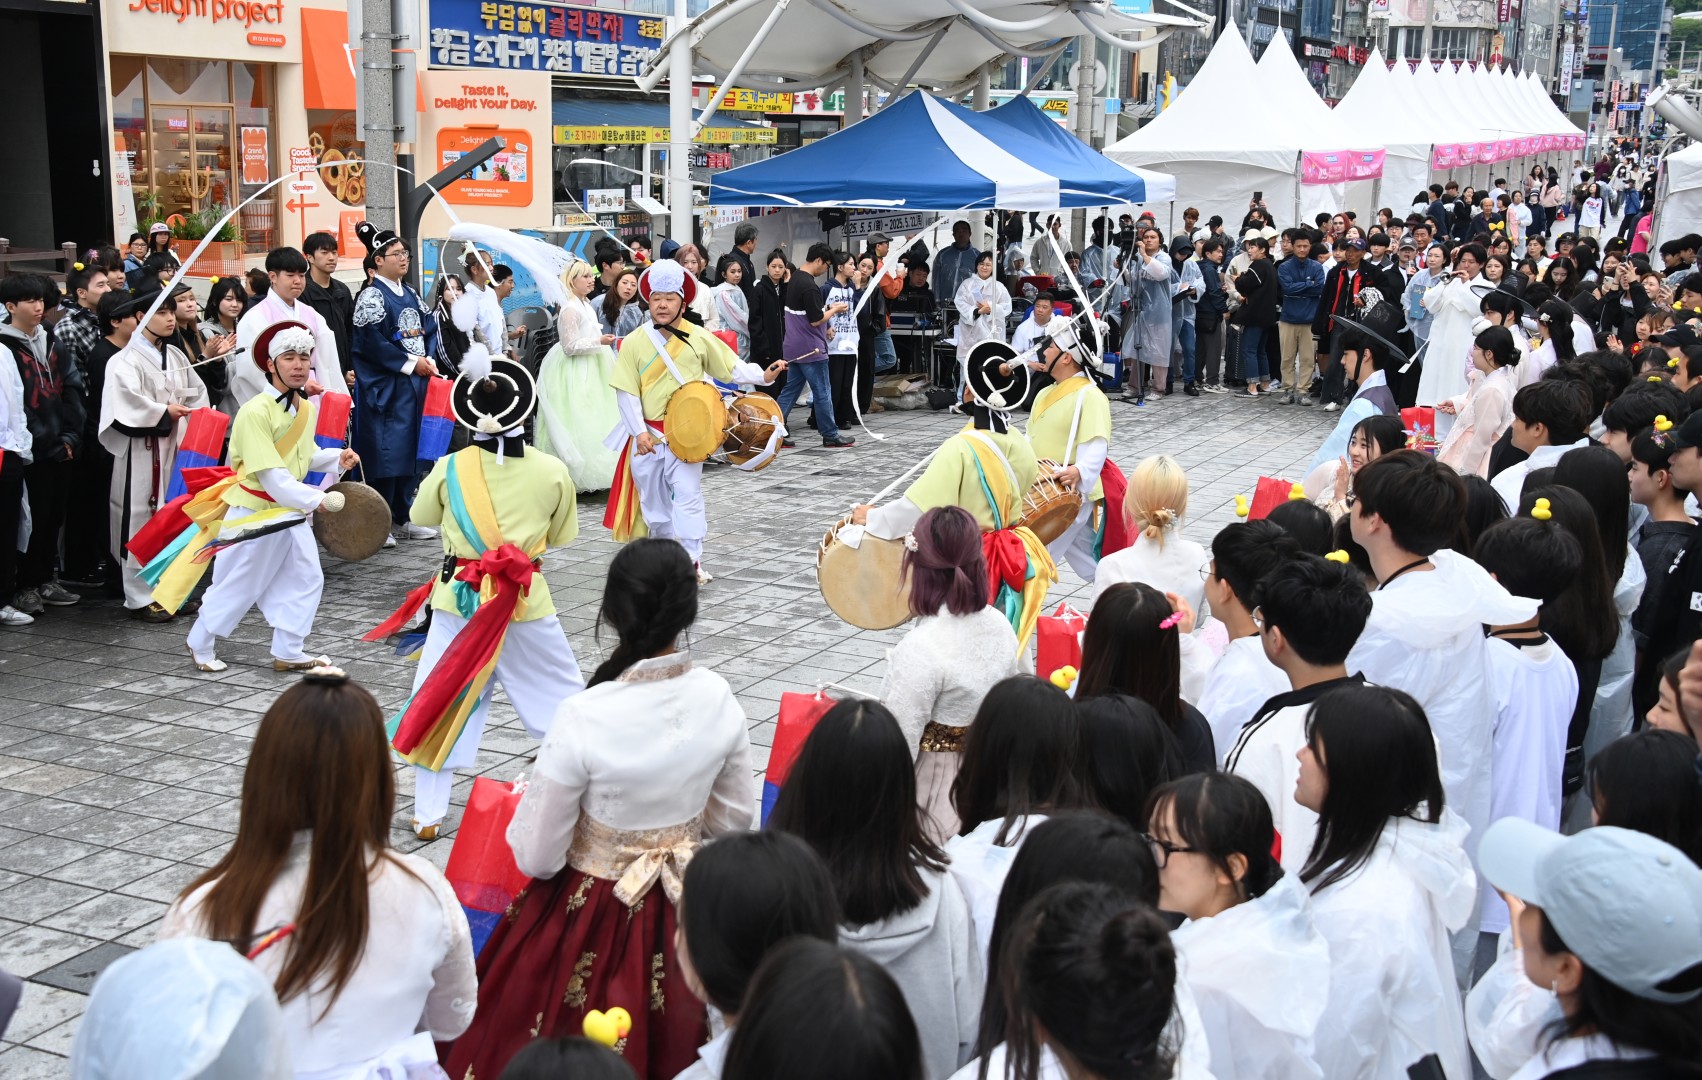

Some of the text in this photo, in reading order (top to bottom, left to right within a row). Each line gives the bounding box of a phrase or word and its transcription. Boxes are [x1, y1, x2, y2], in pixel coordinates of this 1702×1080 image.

[212, 0, 285, 28] project
[638, 19, 663, 39] 3호점
[431, 28, 470, 64] 황금
[474, 34, 540, 69] 조개구이
[541, 38, 573, 71] 횟집
[574, 40, 619, 74] 해물탕
[461, 85, 509, 97] Taste It,
[711, 90, 791, 107] 금 조개구이 회
[434, 98, 537, 111] Delight Your Day.
[461, 136, 483, 145] Delight
[889, 217, 905, 230] 2025.
